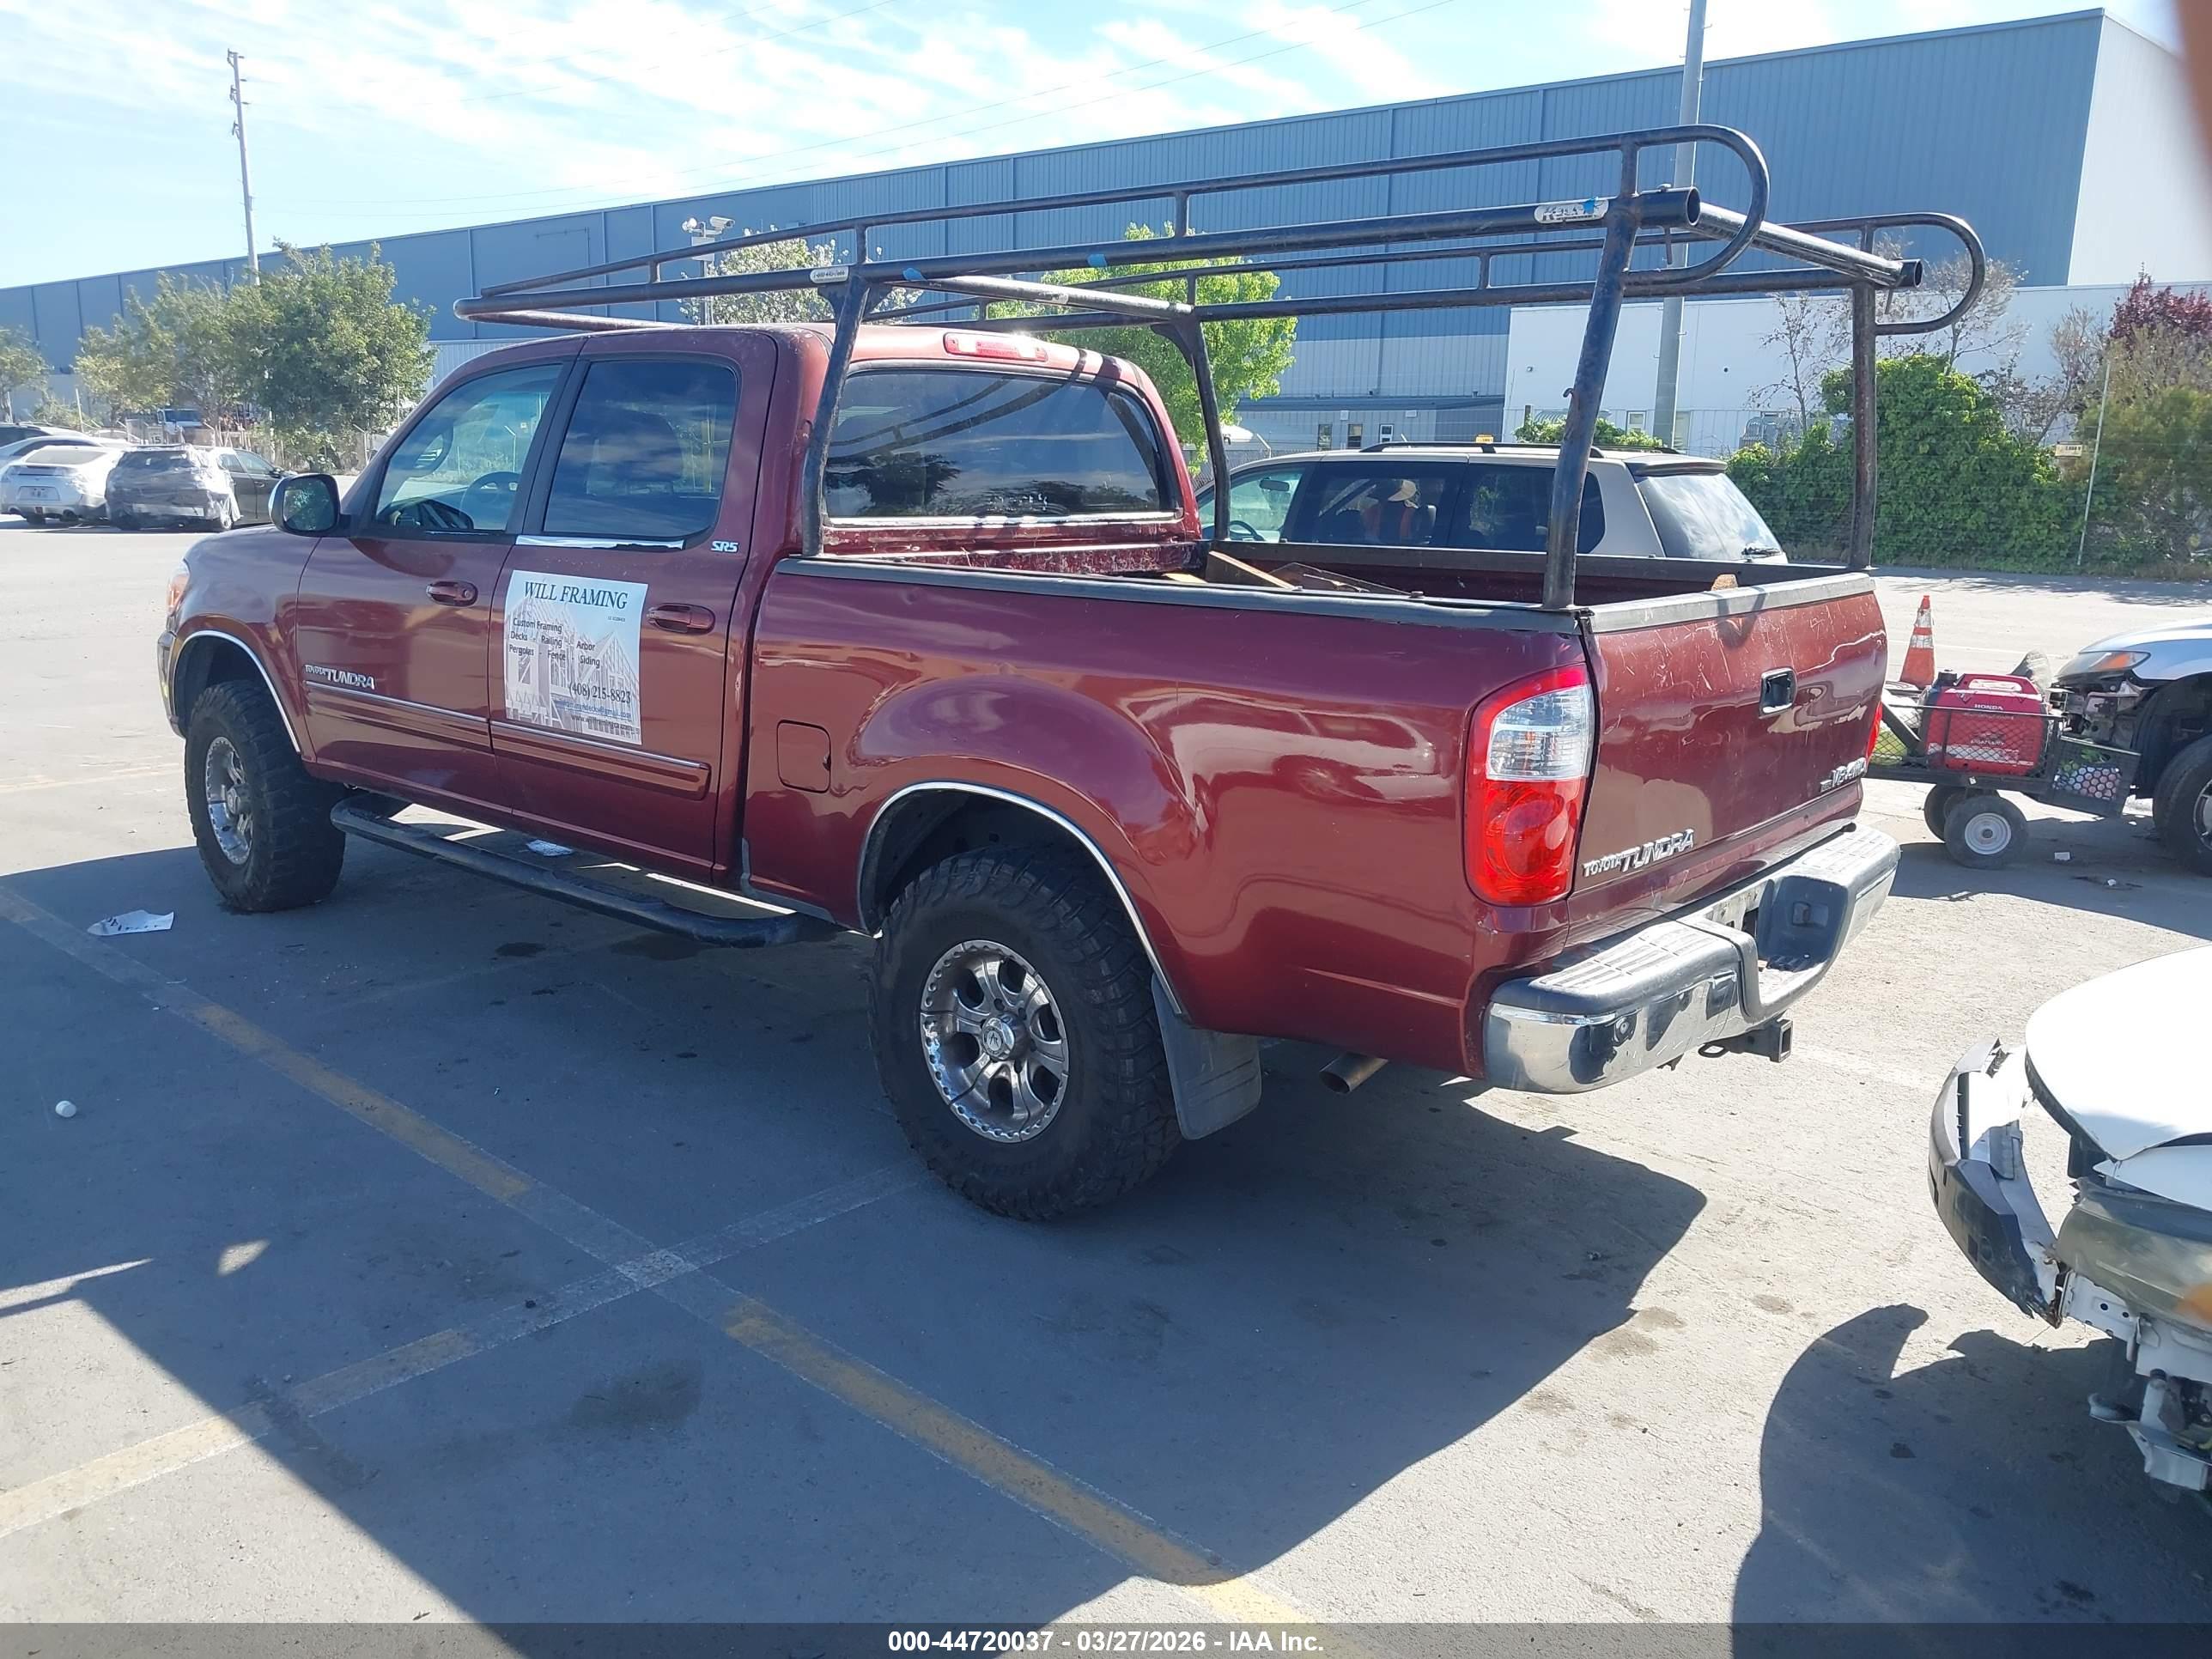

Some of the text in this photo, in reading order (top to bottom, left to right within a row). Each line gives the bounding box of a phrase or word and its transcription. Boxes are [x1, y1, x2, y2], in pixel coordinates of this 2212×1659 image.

[711, 540, 738, 552] SR5
[525, 581, 628, 609] WILL FRAMING
[513, 618, 562, 635] Custom Framing
[511, 631, 528, 641] Decks
[541, 635, 562, 649] Railing
[576, 641, 596, 652] Arbor
[509, 644, 534, 657] Pergolas
[548, 650, 566, 661] Fence
[580, 655, 600, 669] Siding
[325, 668, 375, 690] TUNDRA
[569, 682, 631, 704] (408) 215-8823
[1583, 829, 1694, 877] TOYOTA TUNDRA
